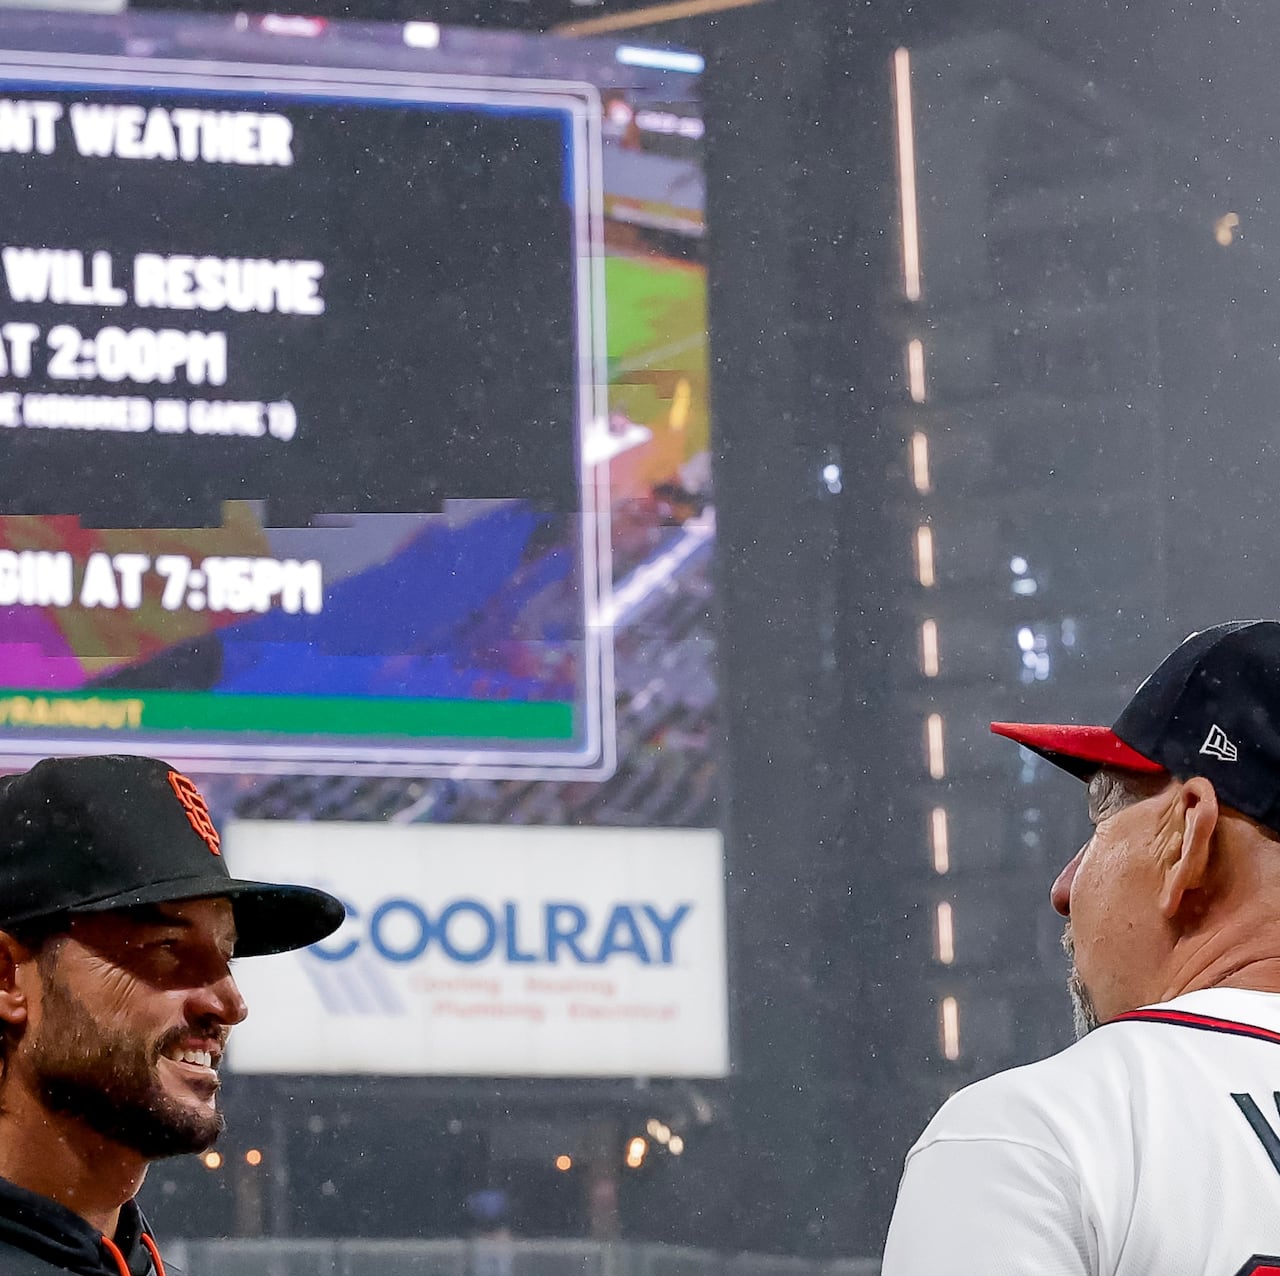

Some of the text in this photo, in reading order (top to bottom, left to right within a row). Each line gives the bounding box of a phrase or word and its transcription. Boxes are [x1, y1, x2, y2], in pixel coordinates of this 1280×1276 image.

[71, 103, 293, 165] WEATHER
[2, 247, 127, 306] WILL
[134, 253, 324, 314] RESUME
[47, 324, 227, 385] 2:00PM
[188, 400, 265, 437] GAME
[81, 552, 150, 609] AT
[156, 553, 323, 615] 7:15PM
